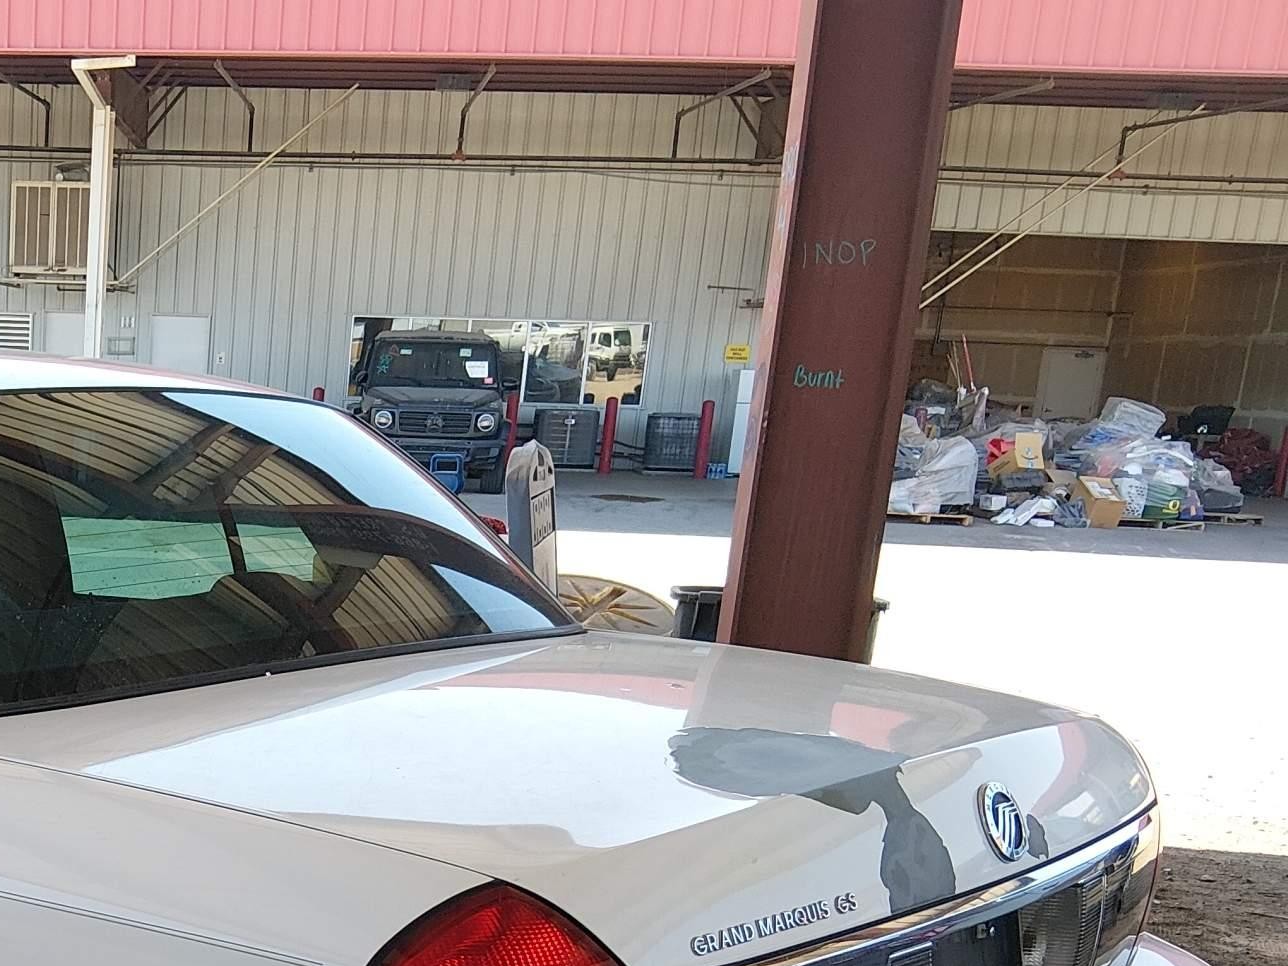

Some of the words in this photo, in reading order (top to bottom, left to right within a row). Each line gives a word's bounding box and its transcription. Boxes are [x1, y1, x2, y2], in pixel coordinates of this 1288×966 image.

[802, 238, 877, 269] INOP
[793, 364, 845, 389] Burnt
[690, 922, 754, 956] GRAND
[755, 900, 831, 938] MARQUIS
[834, 892, 859, 914] GS
